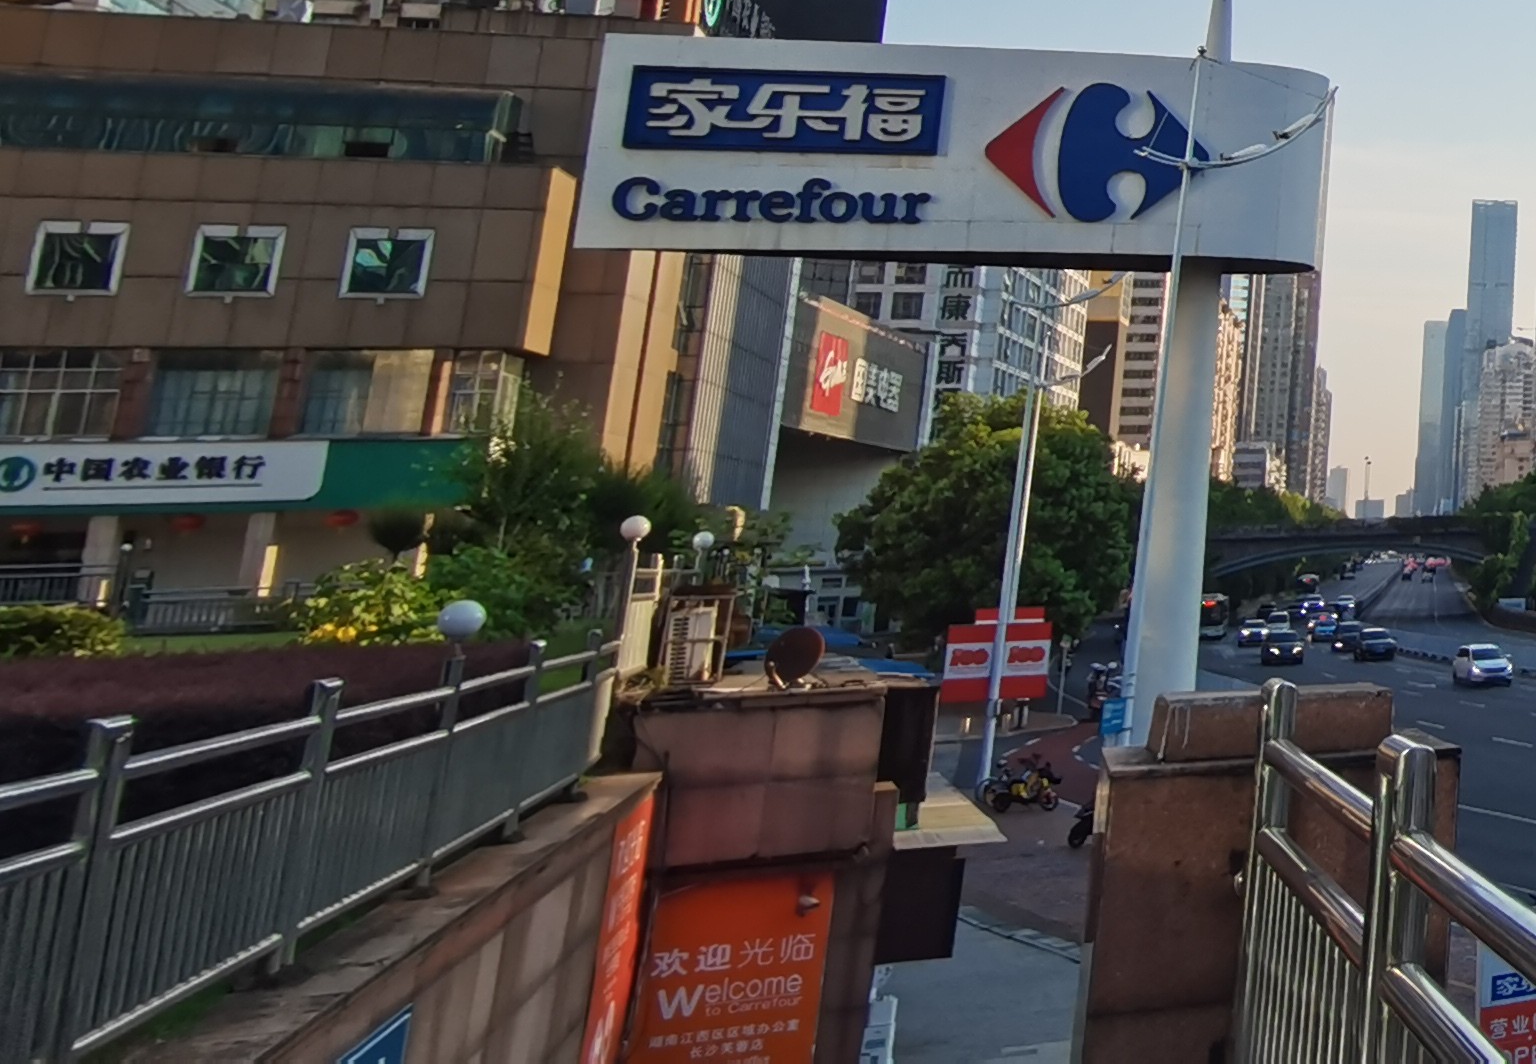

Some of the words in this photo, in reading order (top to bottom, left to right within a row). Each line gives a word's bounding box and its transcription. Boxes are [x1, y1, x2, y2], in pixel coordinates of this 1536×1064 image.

[645, 78, 927, 142] 家乐福
[612, 176, 931, 224] Carrefour
[43, 455, 266, 483] 中国农业银行
[650, 933, 817, 978] 欢迎光临
[657, 974, 802, 1020] Welcome
[728, 995, 802, 1014] Carrefour
